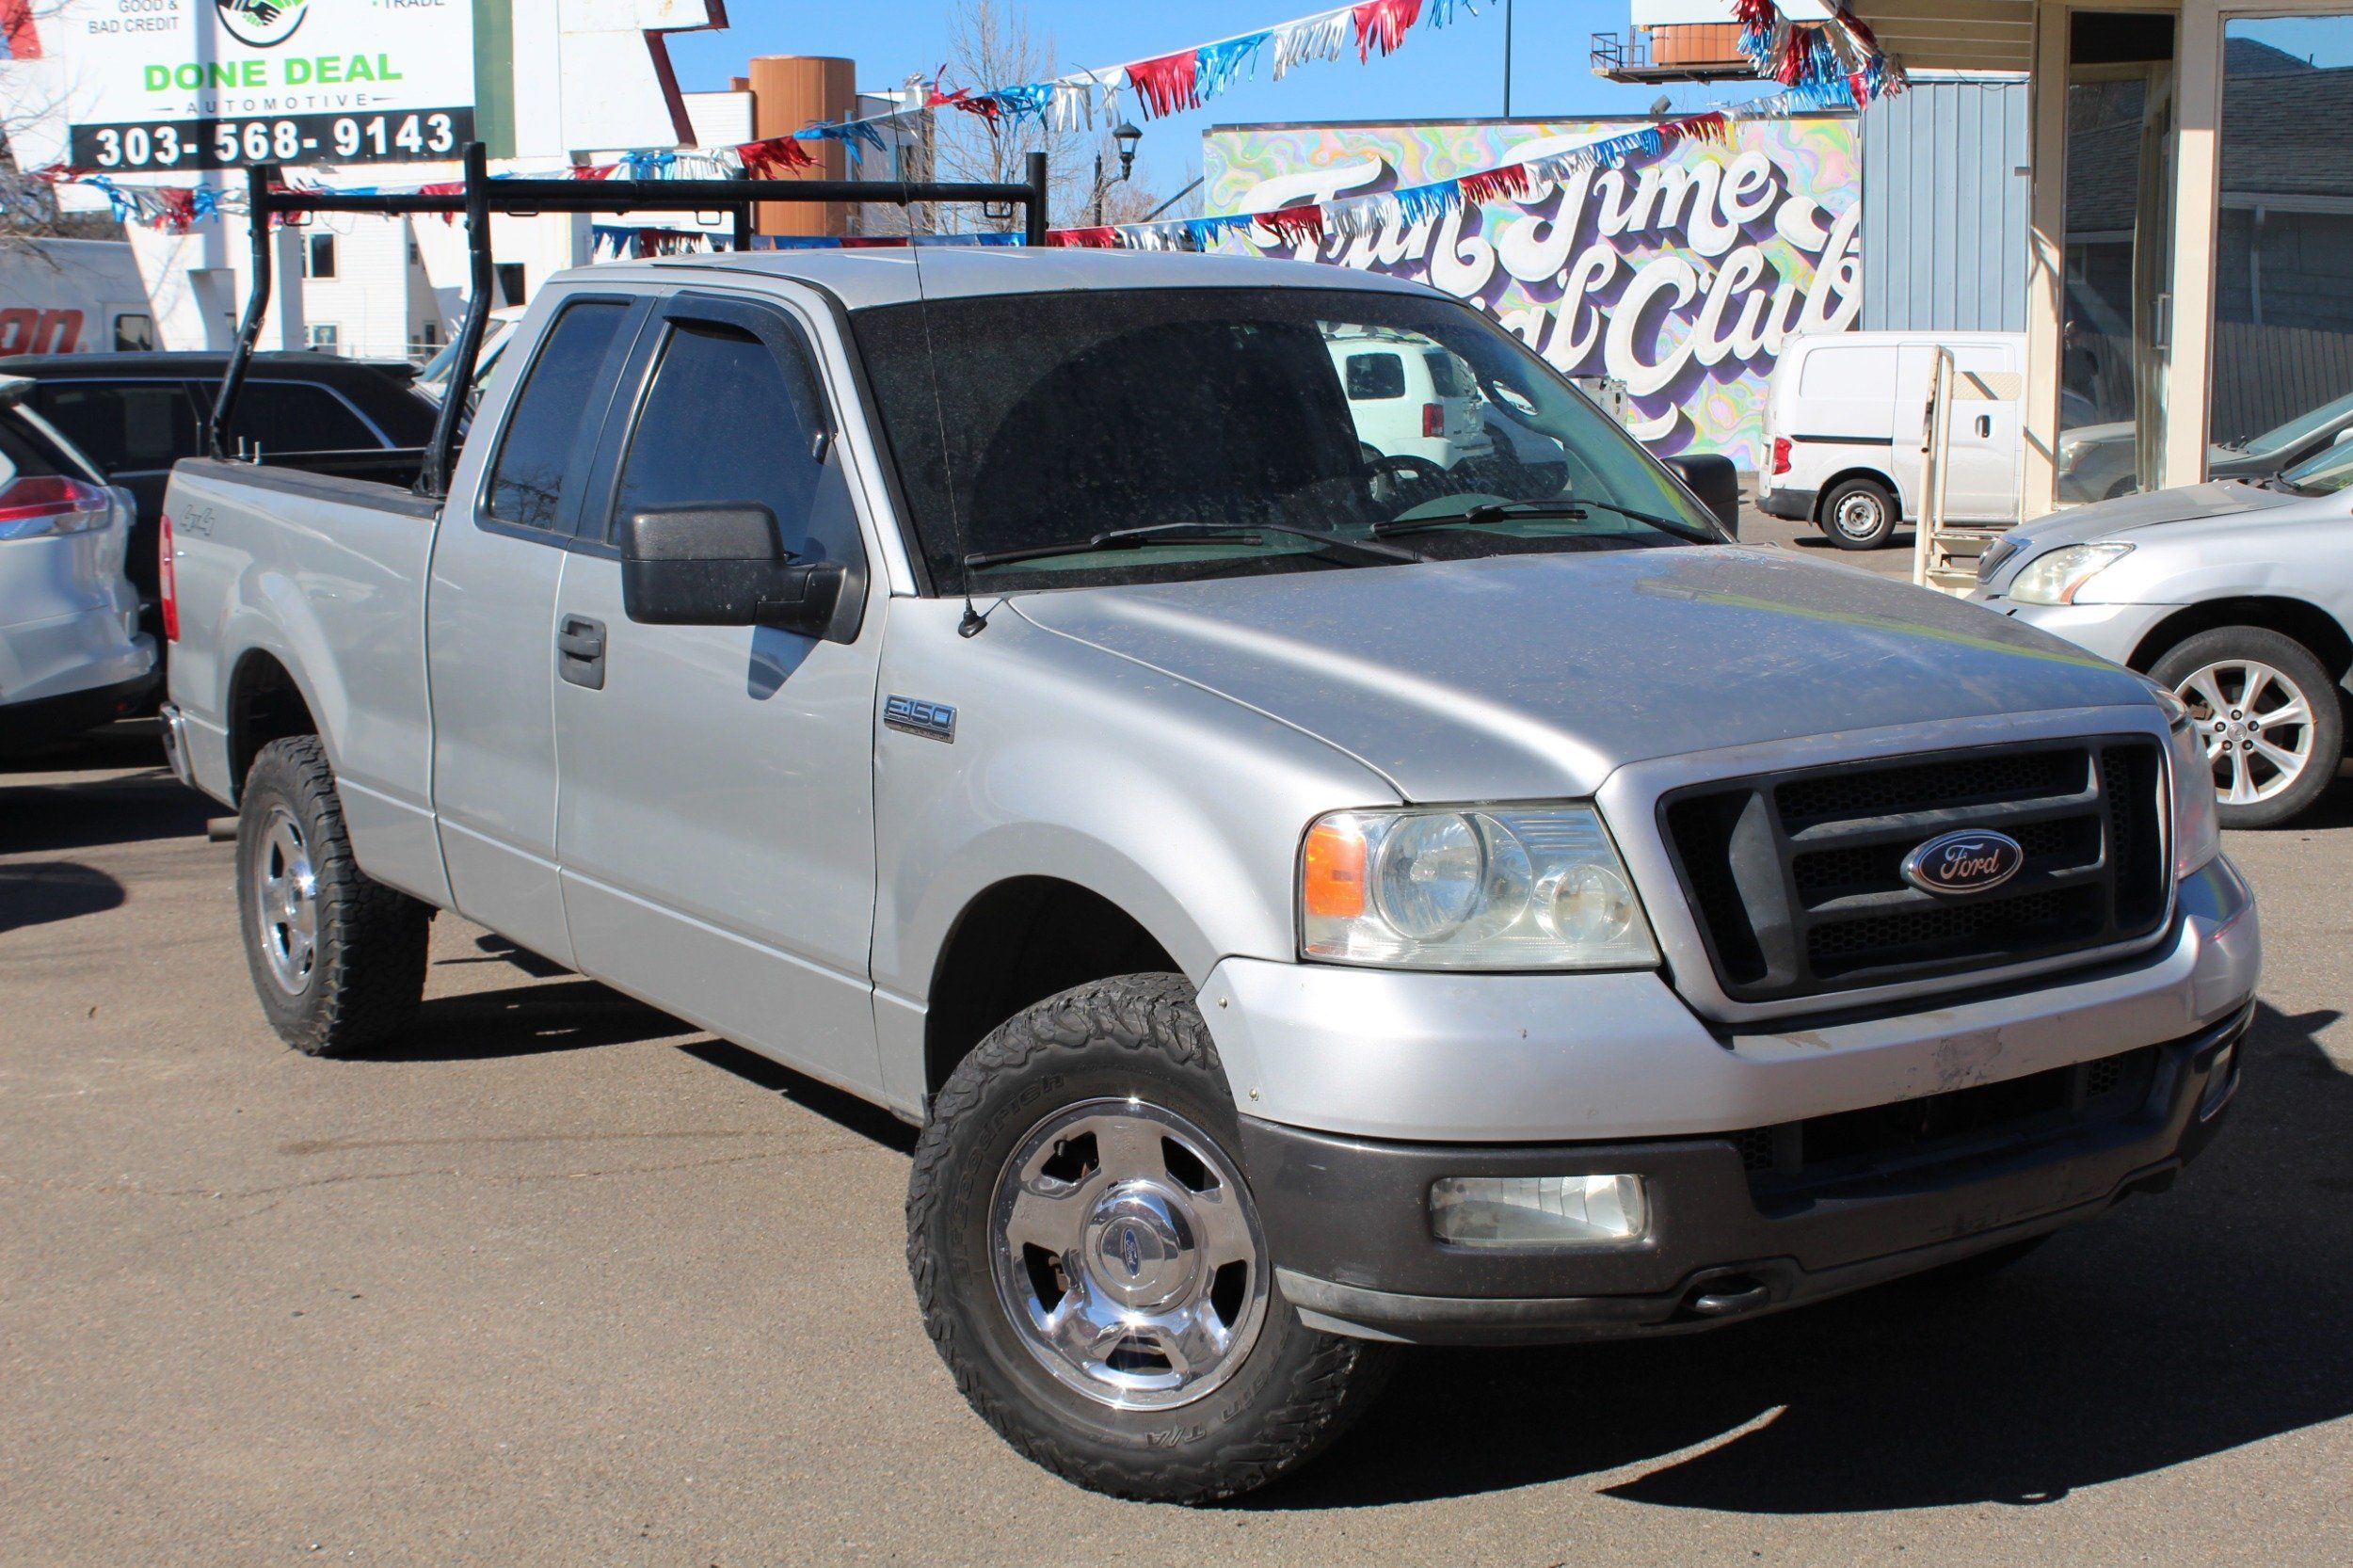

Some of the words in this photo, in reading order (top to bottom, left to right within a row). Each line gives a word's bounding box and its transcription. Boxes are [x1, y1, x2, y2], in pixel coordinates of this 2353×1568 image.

[88, 21, 120, 34] BAD
[124, 17, 179, 33] CREDIT
[119, 0, 163, 12] GOOD
[168, 0, 178, 10] &
[144, 60, 267, 92] DONE
[285, 53, 403, 86] DEAL
[186, 93, 368, 115] AUTOMOTIVE
[1497, 125, 1779, 282] Time
[1604, 196, 1860, 397] Club
[1940, 842, 2000, 881] Ford
